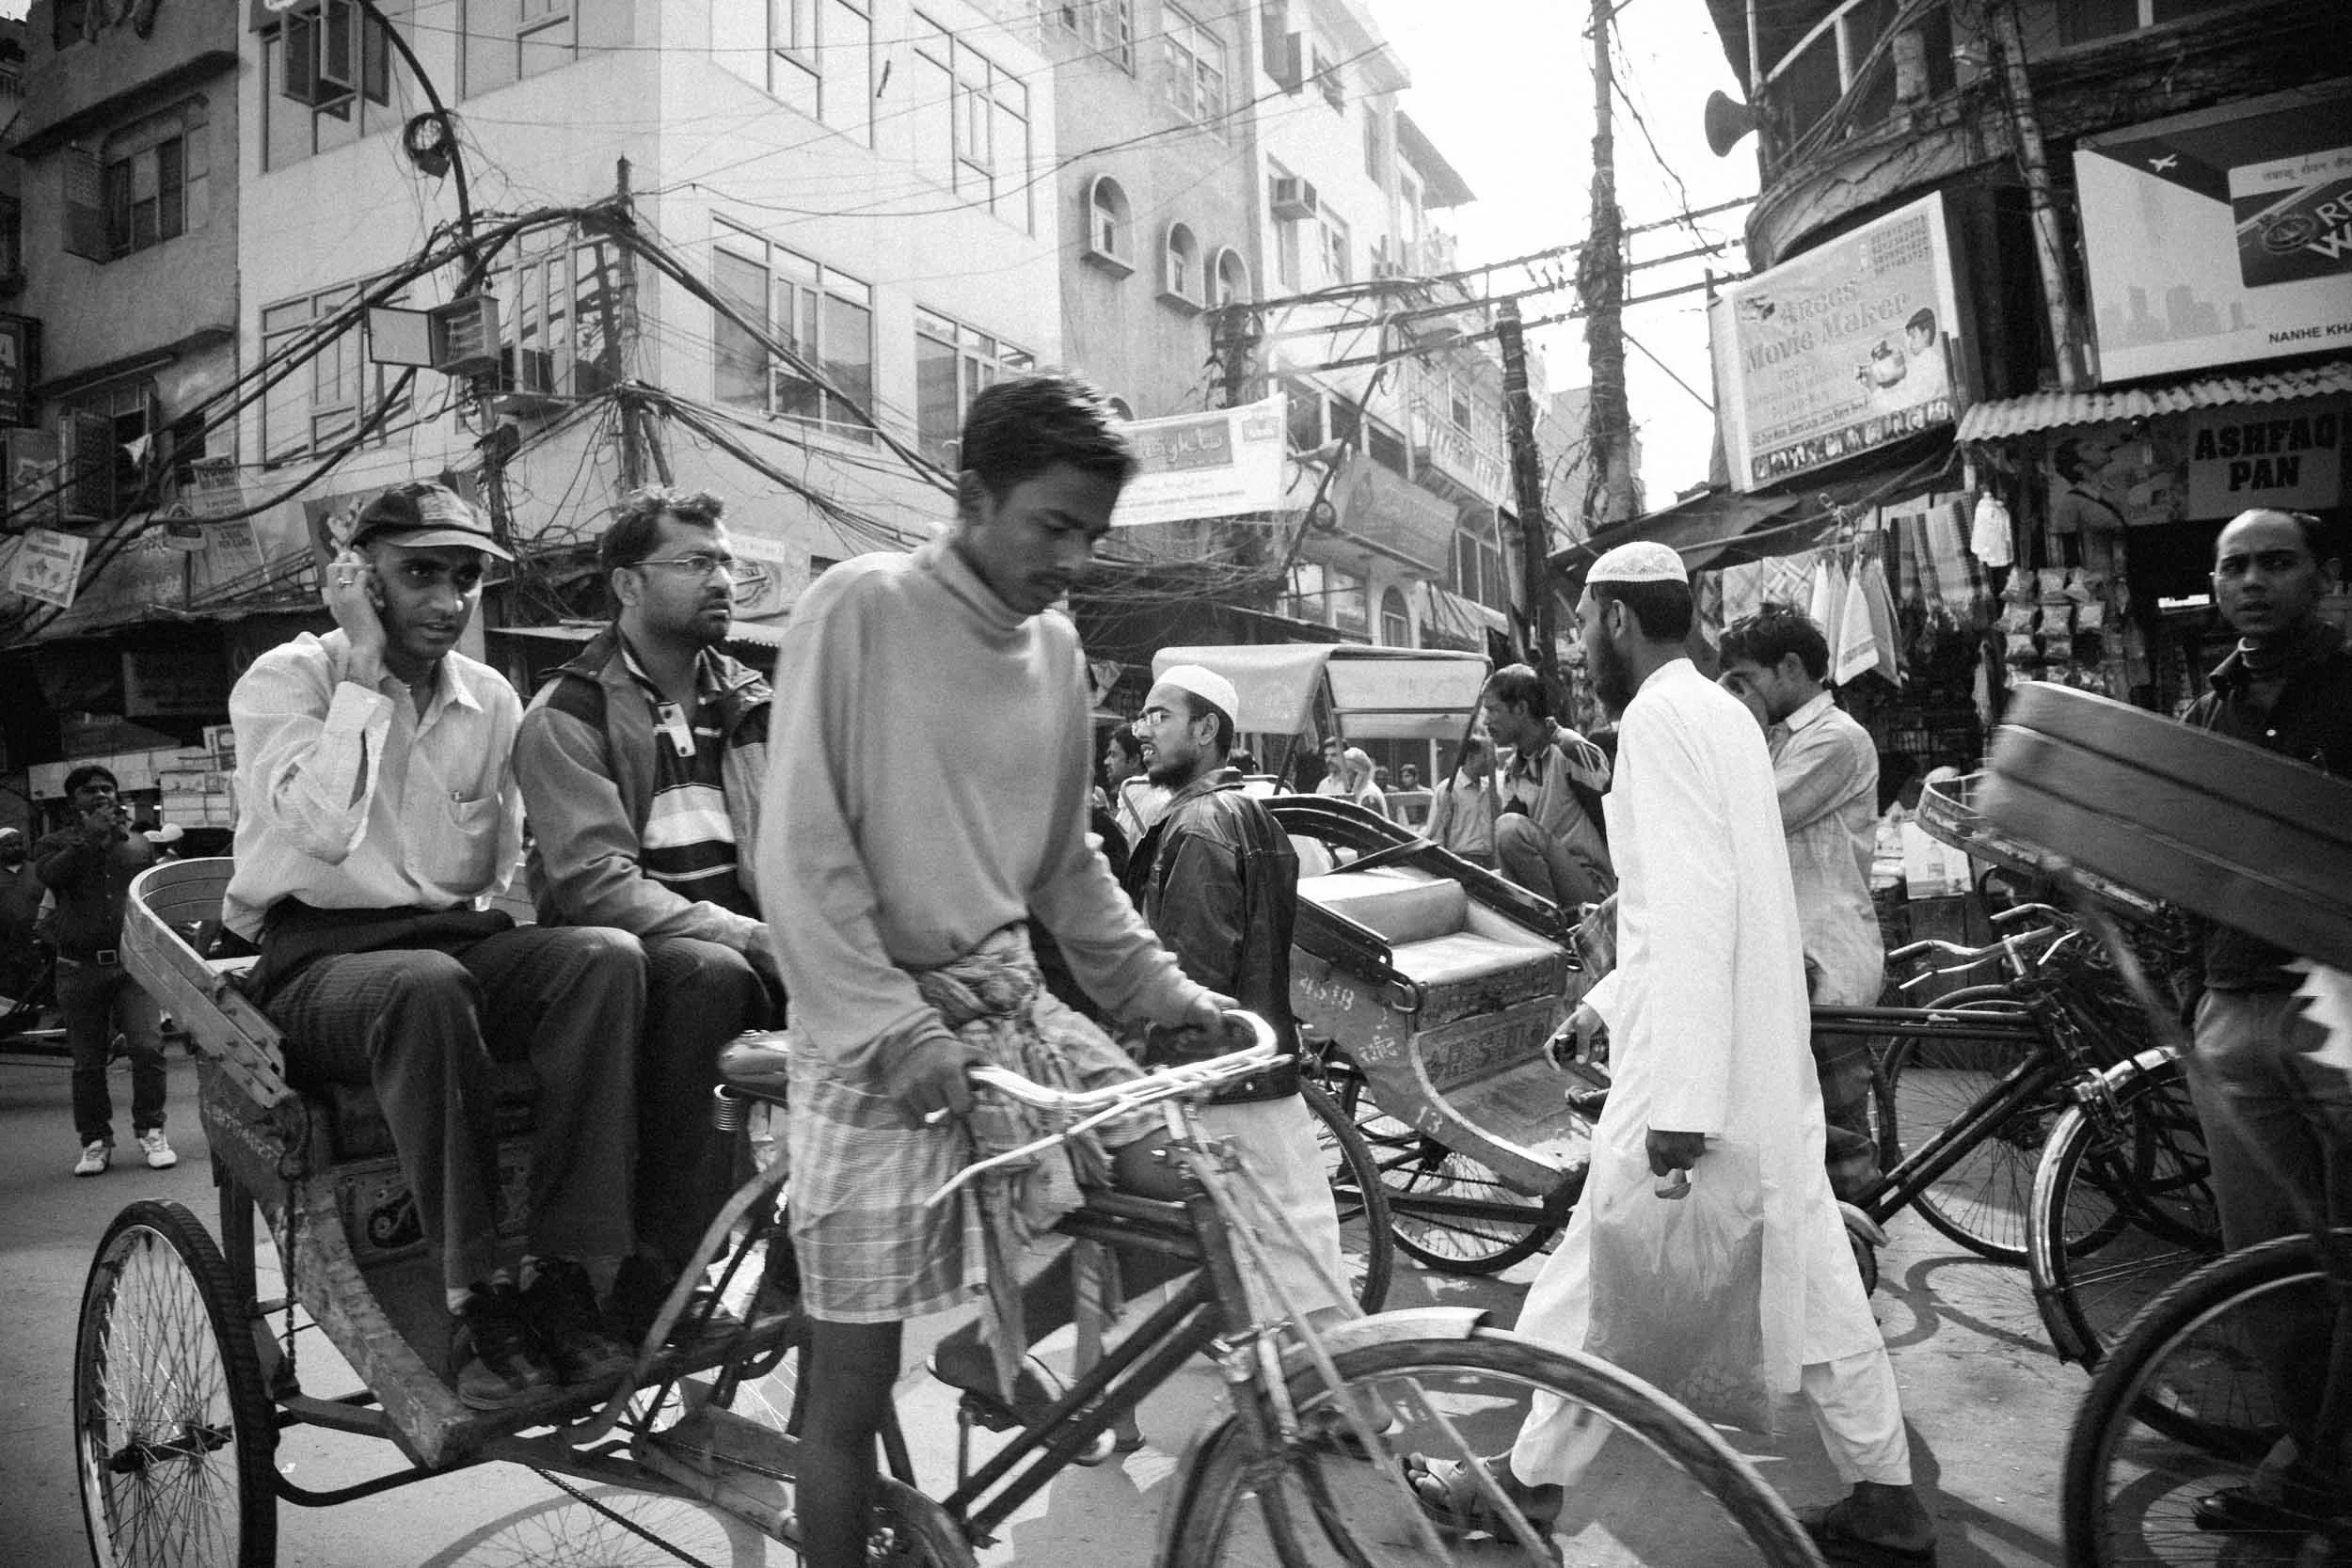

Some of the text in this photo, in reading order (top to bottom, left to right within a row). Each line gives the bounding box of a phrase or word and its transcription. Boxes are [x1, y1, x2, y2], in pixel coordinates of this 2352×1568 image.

[1745, 293, 1908, 374] Movie Maker
[2268, 326, 2323, 343] NANHE
[2195, 414, 2337, 461] ASHFAQ
[2229, 455, 2302, 492] PAN
